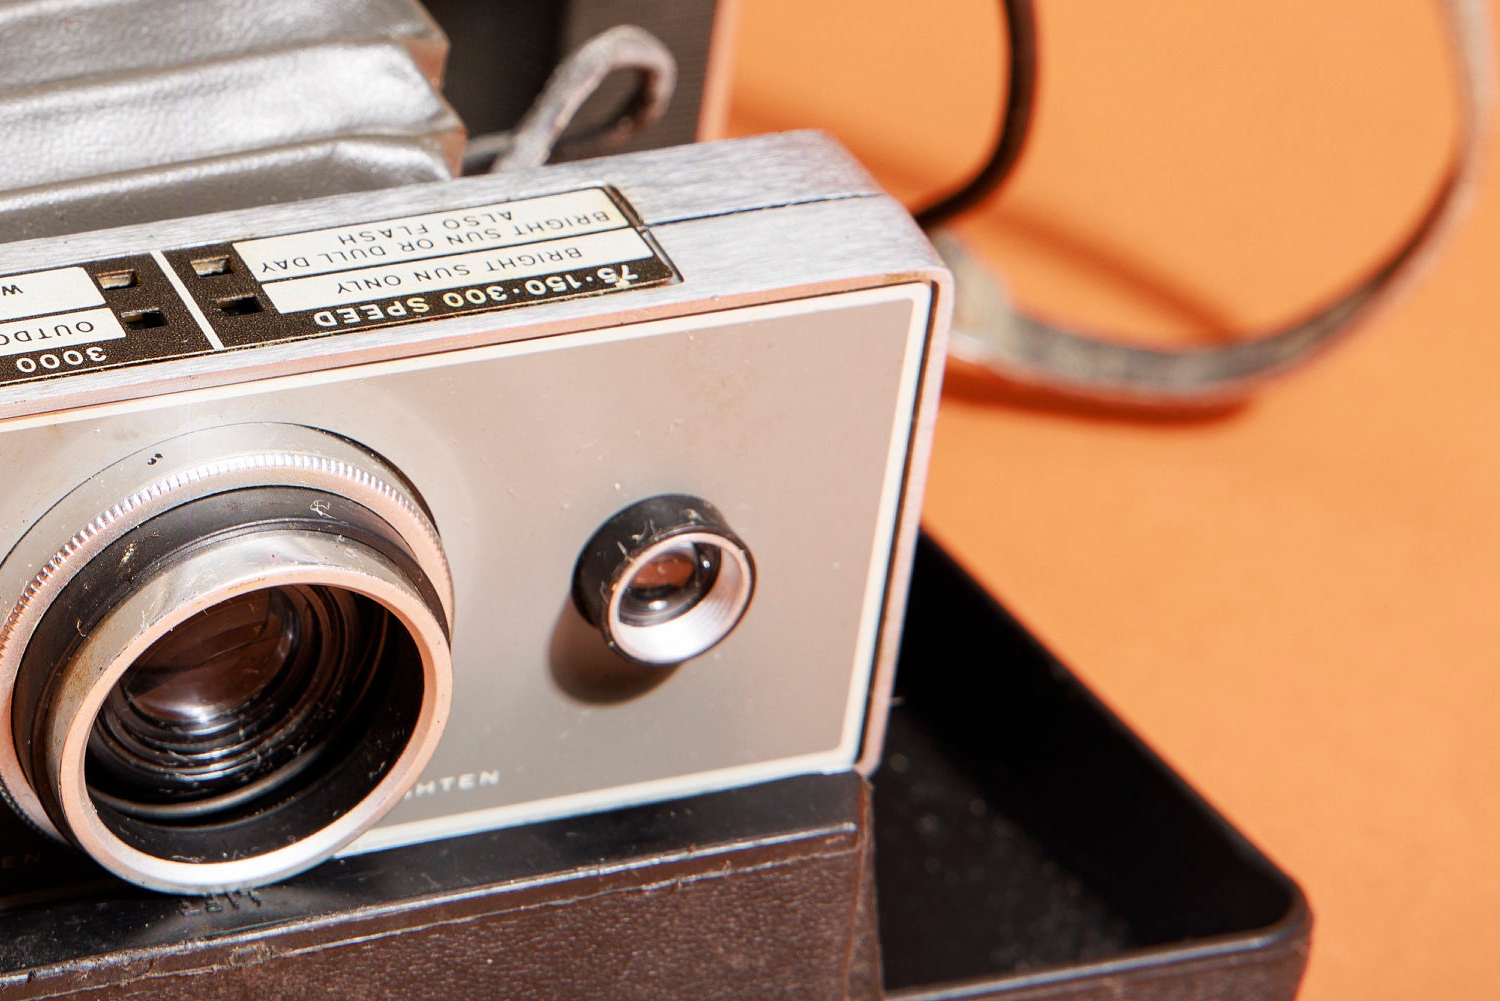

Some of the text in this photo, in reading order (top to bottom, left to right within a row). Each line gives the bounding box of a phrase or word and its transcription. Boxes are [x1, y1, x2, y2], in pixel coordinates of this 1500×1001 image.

[262, 211, 611, 273] BRIGHT SUN OR DULL DAY
[339, 210, 512, 244] ALSO FLASH
[336, 246, 582, 294] BRIGHT SUN ONLY
[314, 297, 430, 326] SPEED
[16, 346, 108, 373] 3000
